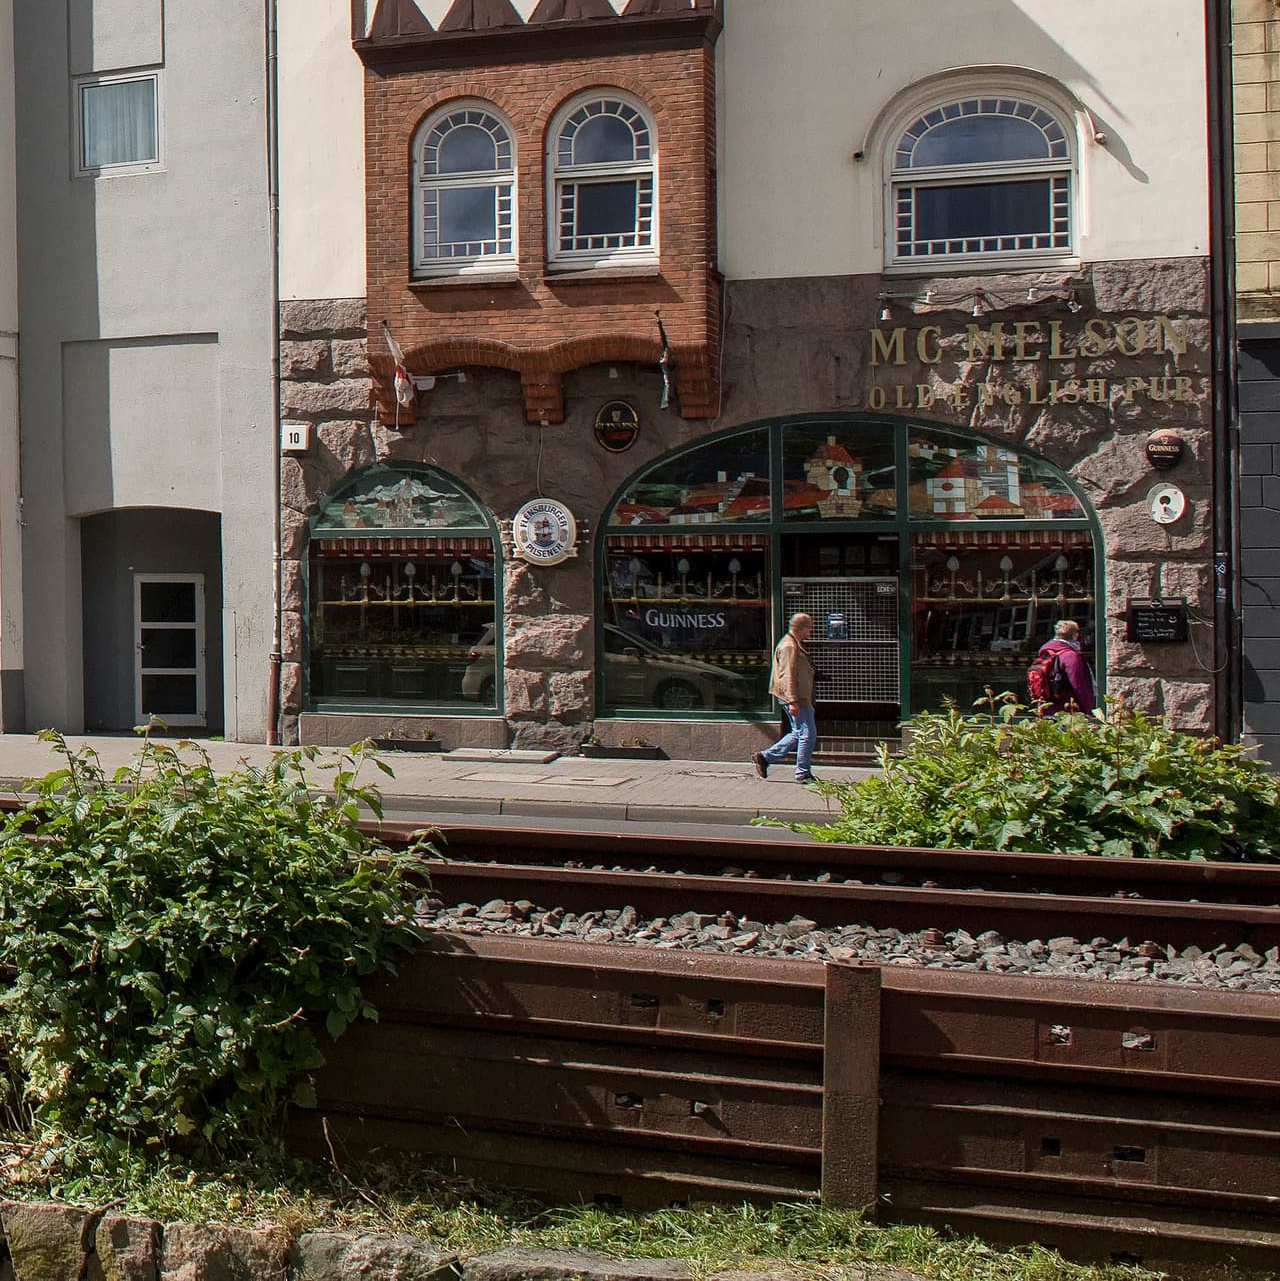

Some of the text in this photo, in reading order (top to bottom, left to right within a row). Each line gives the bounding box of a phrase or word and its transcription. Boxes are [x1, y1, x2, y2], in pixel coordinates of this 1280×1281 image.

[869, 314, 1190, 367] MC MELSON
[869, 376, 1194, 410] OLD ENGLISH PUB
[289, 432, 300, 444] 10
[519, 504, 568, 528] FLENSBURGER
[525, 543, 564, 558] PILSENER
[645, 608, 726, 629] GUINNESS
